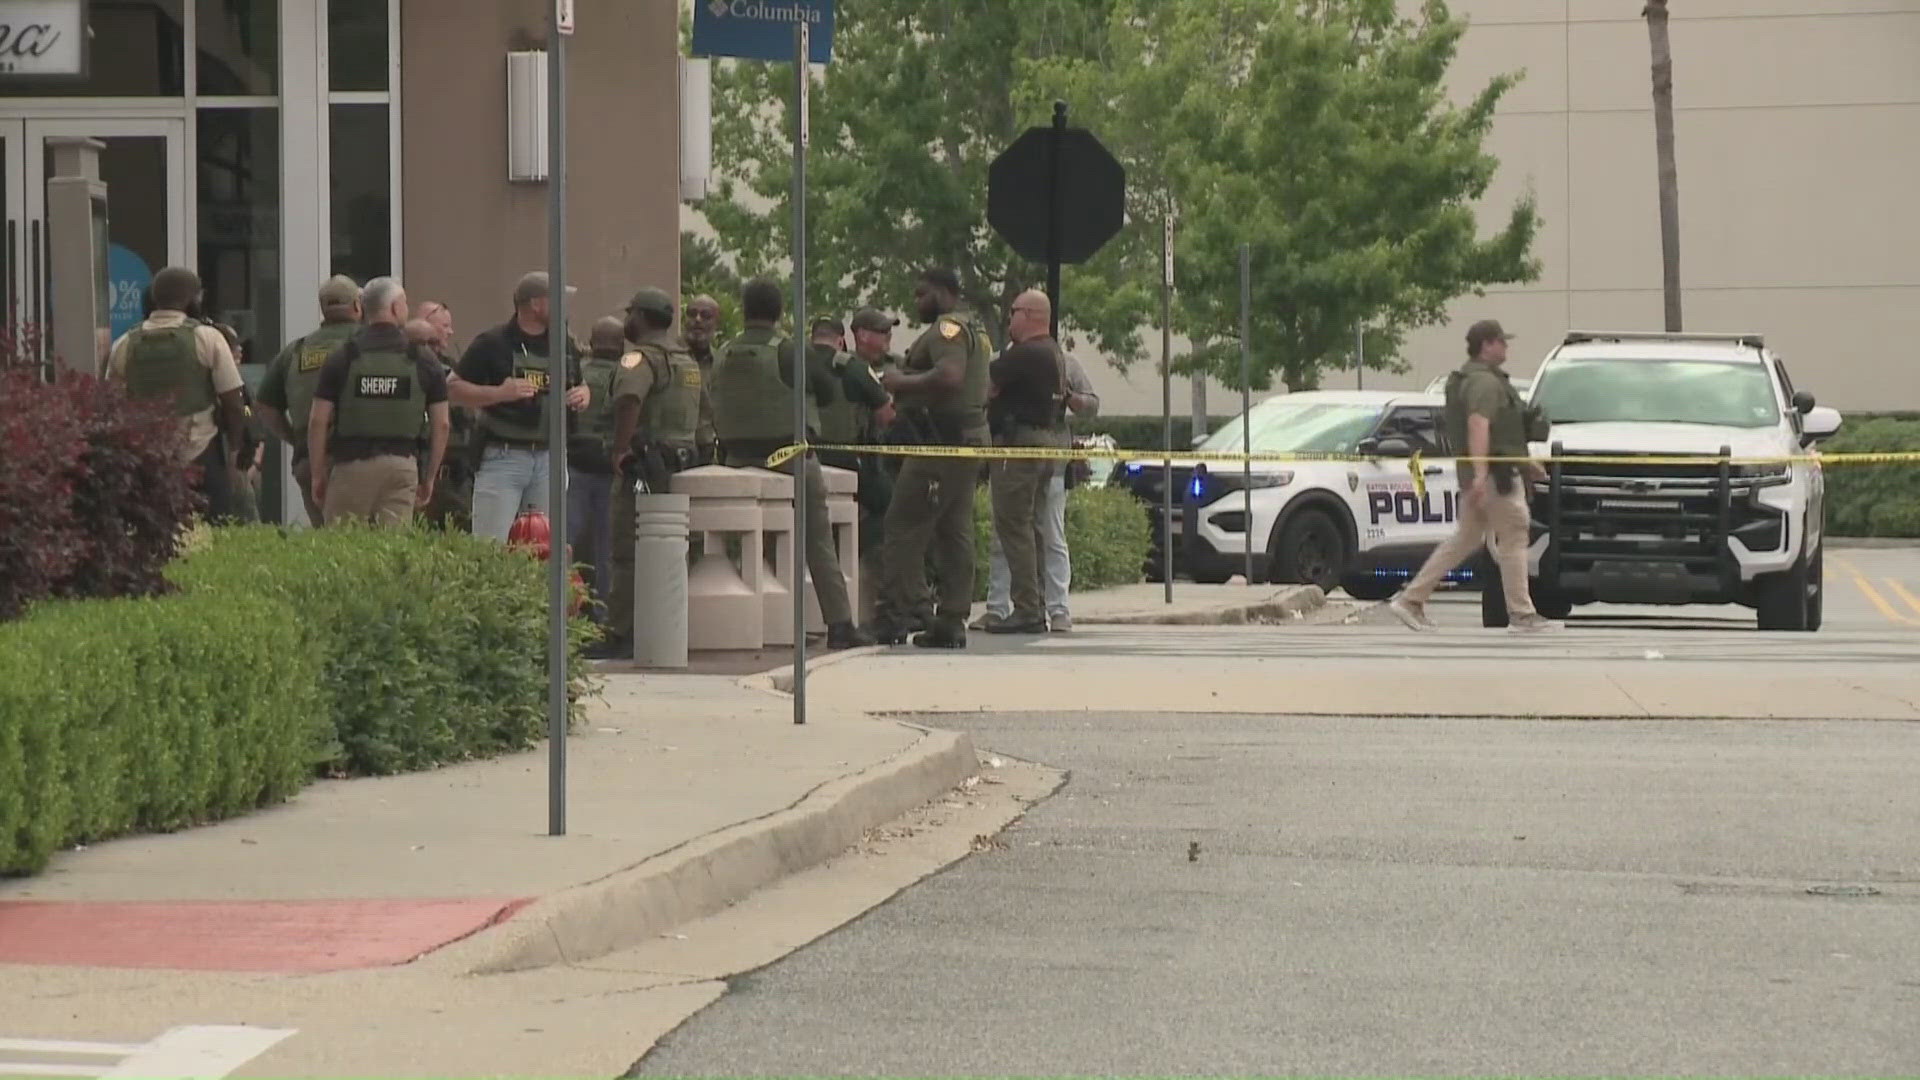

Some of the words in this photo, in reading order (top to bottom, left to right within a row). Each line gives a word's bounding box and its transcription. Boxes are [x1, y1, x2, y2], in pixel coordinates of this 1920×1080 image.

[730, 0, 821, 23] Columbia
[360, 377, 398, 395] SHERIFF
[1368, 491, 1460, 525] POLI
